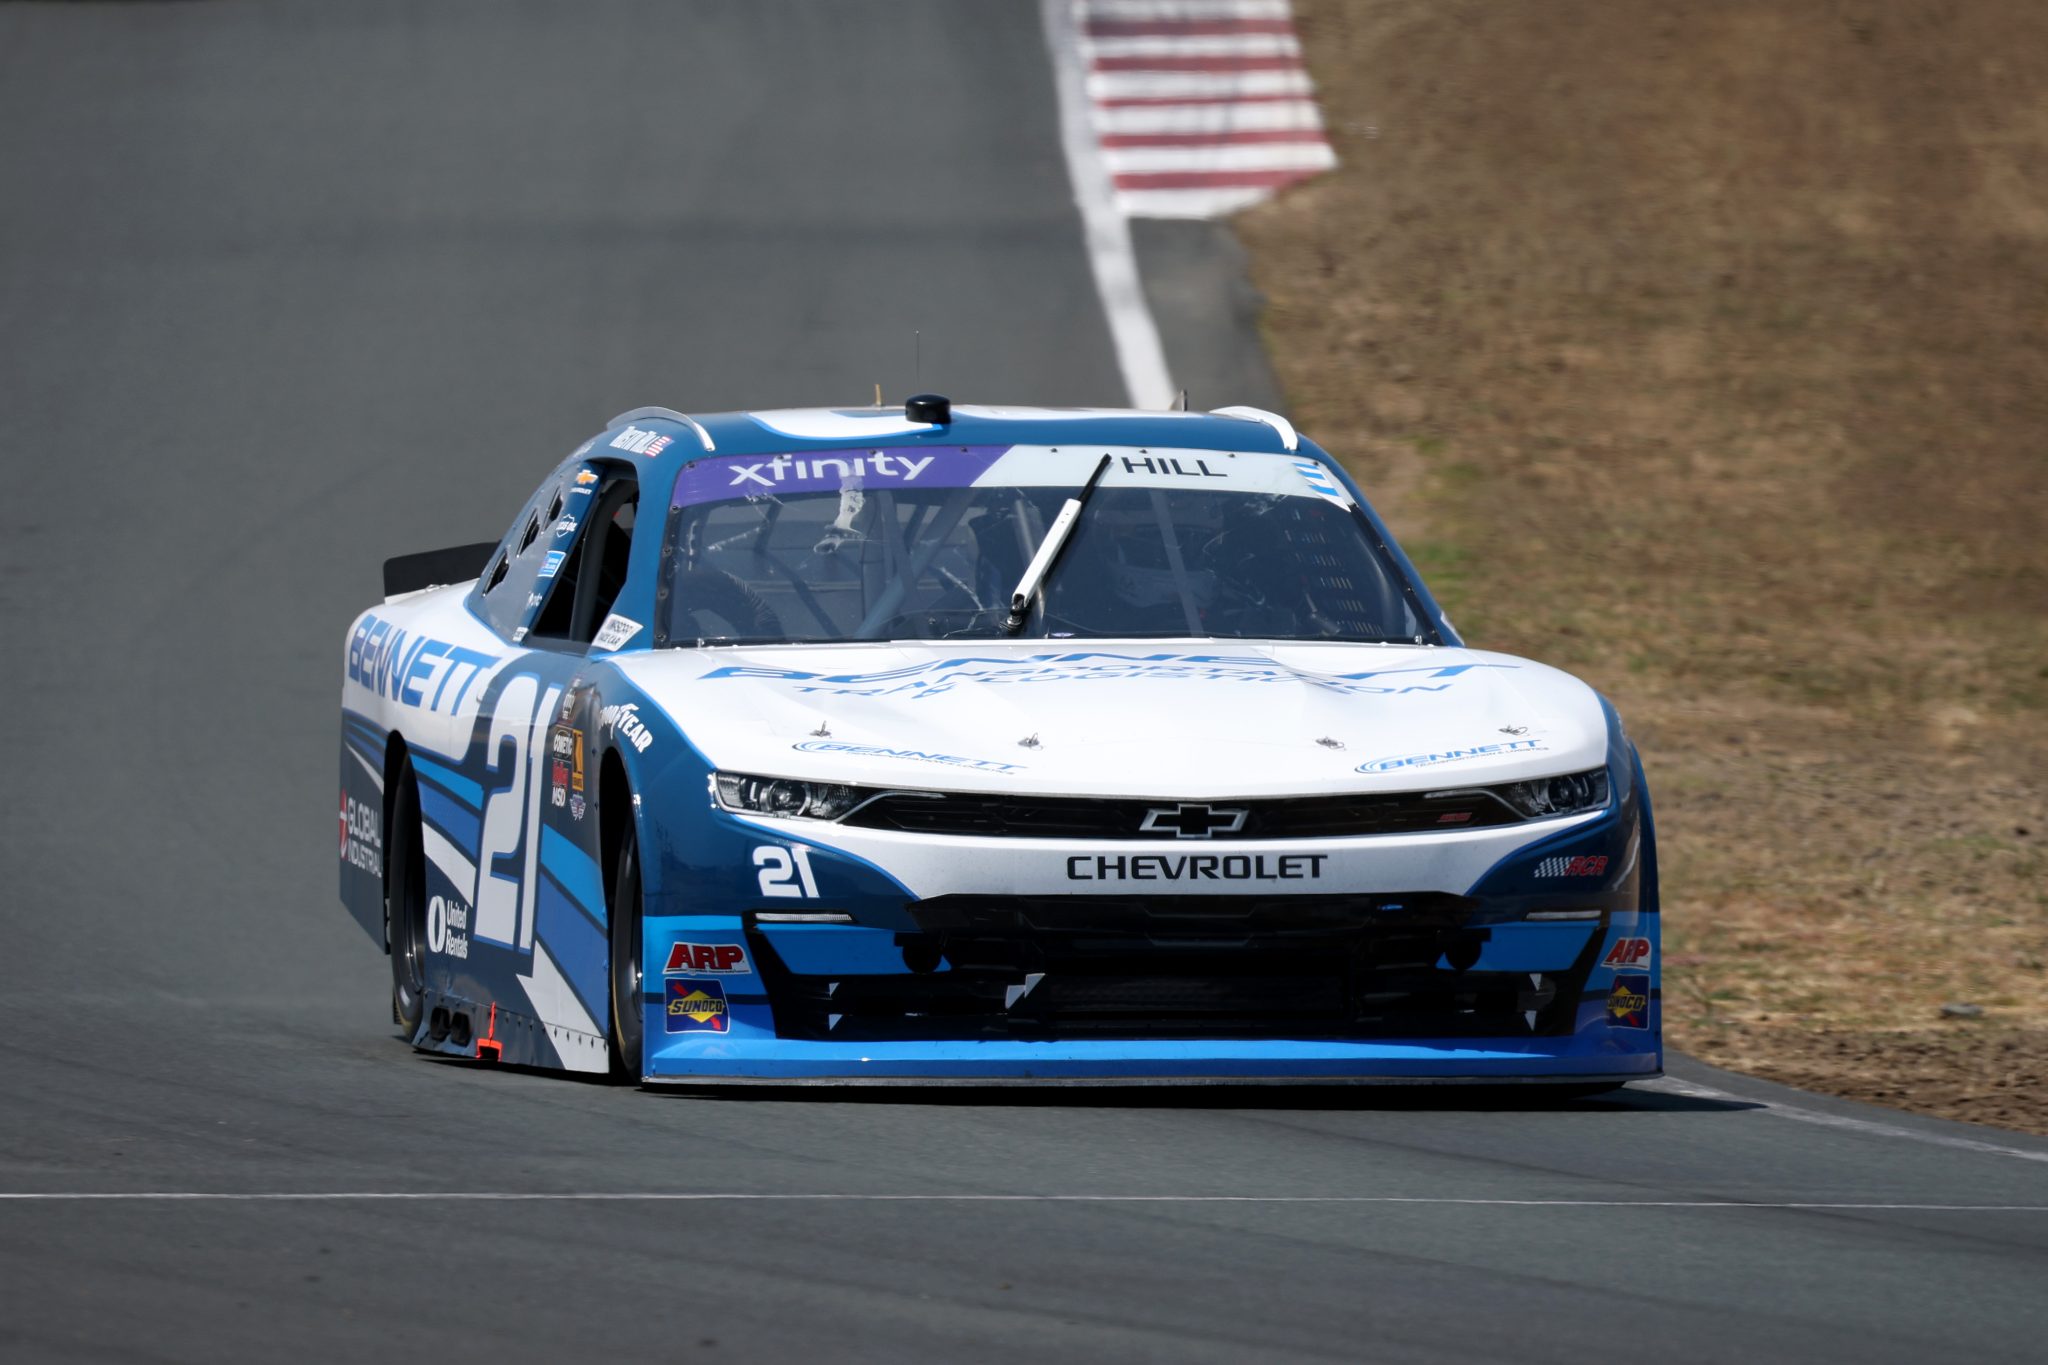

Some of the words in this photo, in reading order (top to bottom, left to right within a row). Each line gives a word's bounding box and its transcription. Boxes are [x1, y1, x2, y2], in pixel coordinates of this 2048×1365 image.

[728, 451, 935, 486] xfinity
[1121, 457, 1228, 477] HILL
[349, 614, 501, 717] BENNETT
[816, 744, 1028, 770] BENNETT
[1380, 739, 1541, 771] BENNETT
[552, 786, 566, 808] MSD
[348, 797, 382, 848] GLOBAL
[474, 672, 565, 952] 21
[348, 838, 383, 878] INDUSTRIAL
[752, 845, 820, 898] 21
[1067, 855, 1328, 880] CHEVROLET
[1564, 856, 1608, 876] RCR
[447, 900, 467, 930] United
[445, 929, 469, 959] Rentals
[667, 943, 744, 969] ARP
[1605, 939, 1650, 963] ARP
[671, 999, 723, 1014] SUNOCO
[1607, 995, 1644, 1011] SUNOCO
